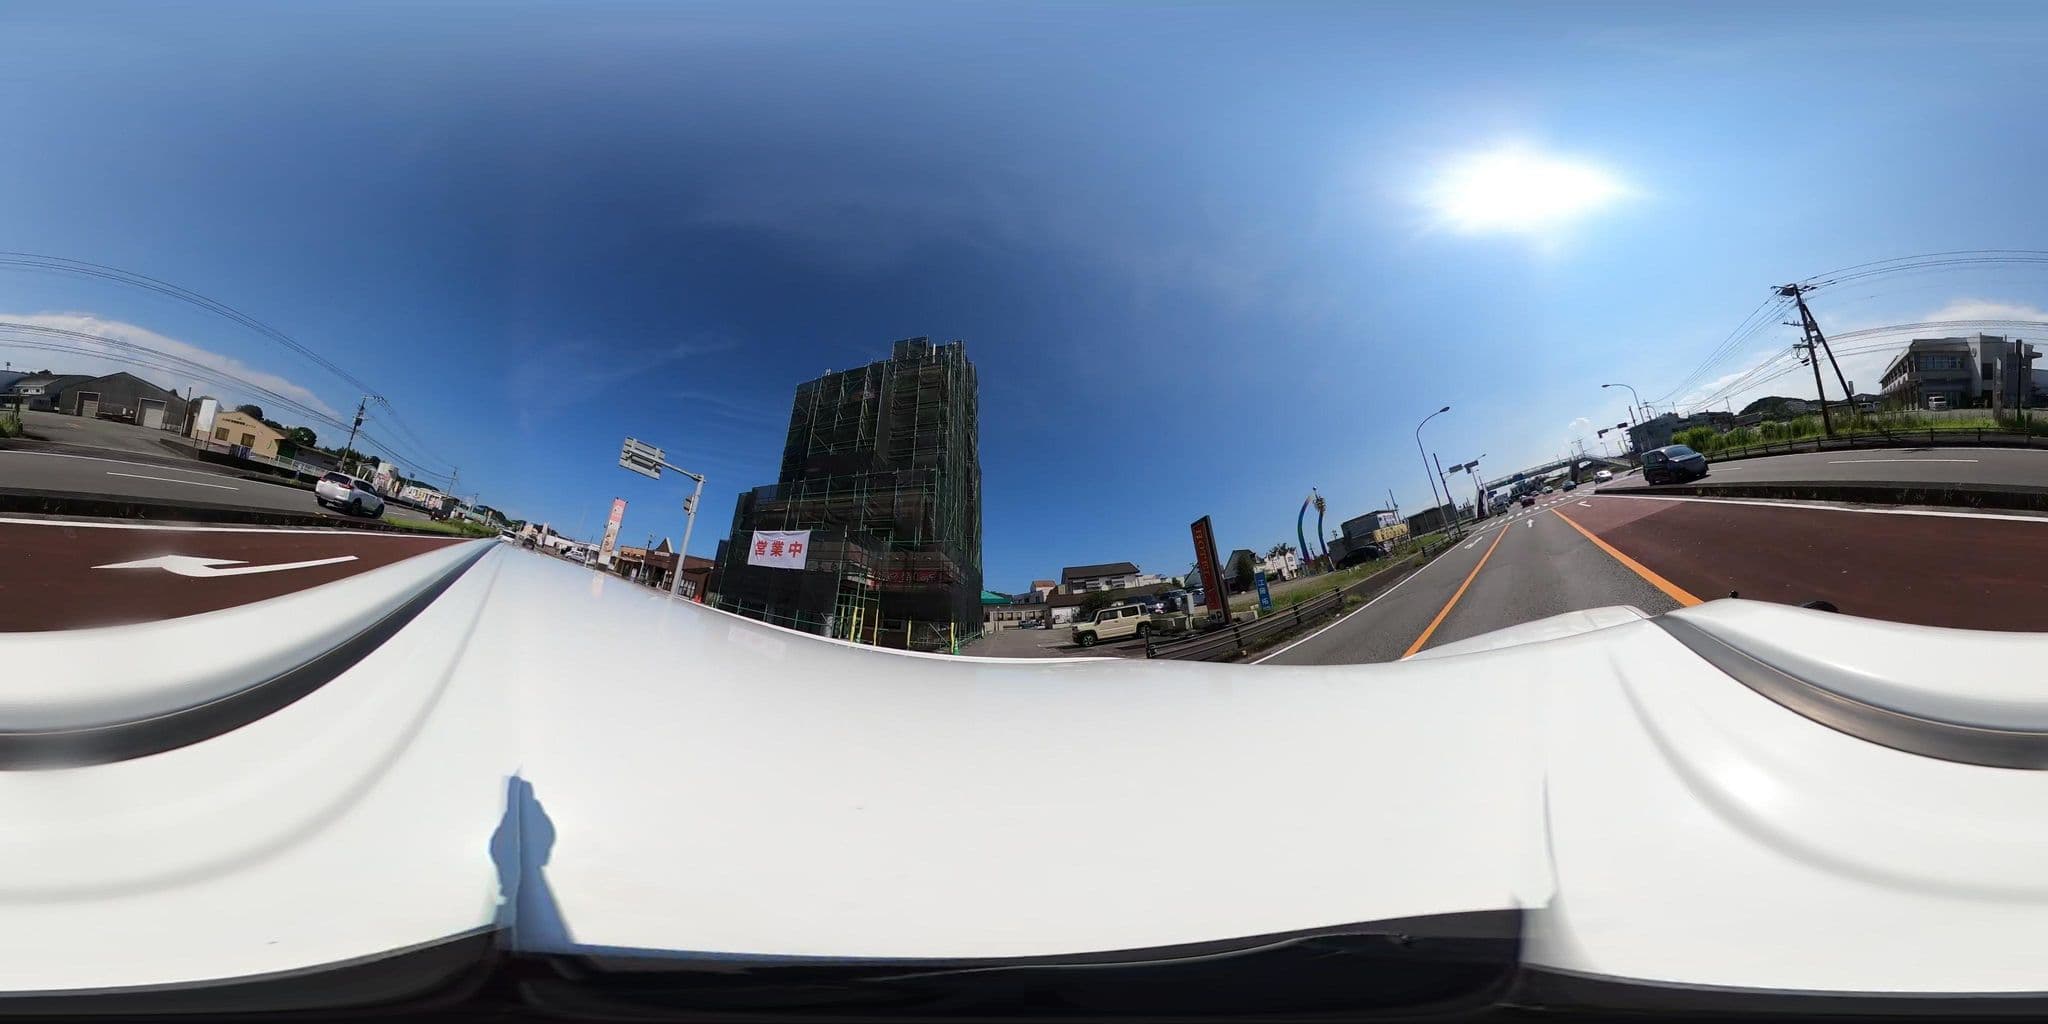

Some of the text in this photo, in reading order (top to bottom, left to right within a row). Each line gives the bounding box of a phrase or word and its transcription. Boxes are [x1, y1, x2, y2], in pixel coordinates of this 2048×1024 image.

[755, 540, 802, 558] 営業中
[1195, 528, 1210, 577] HOTEL
